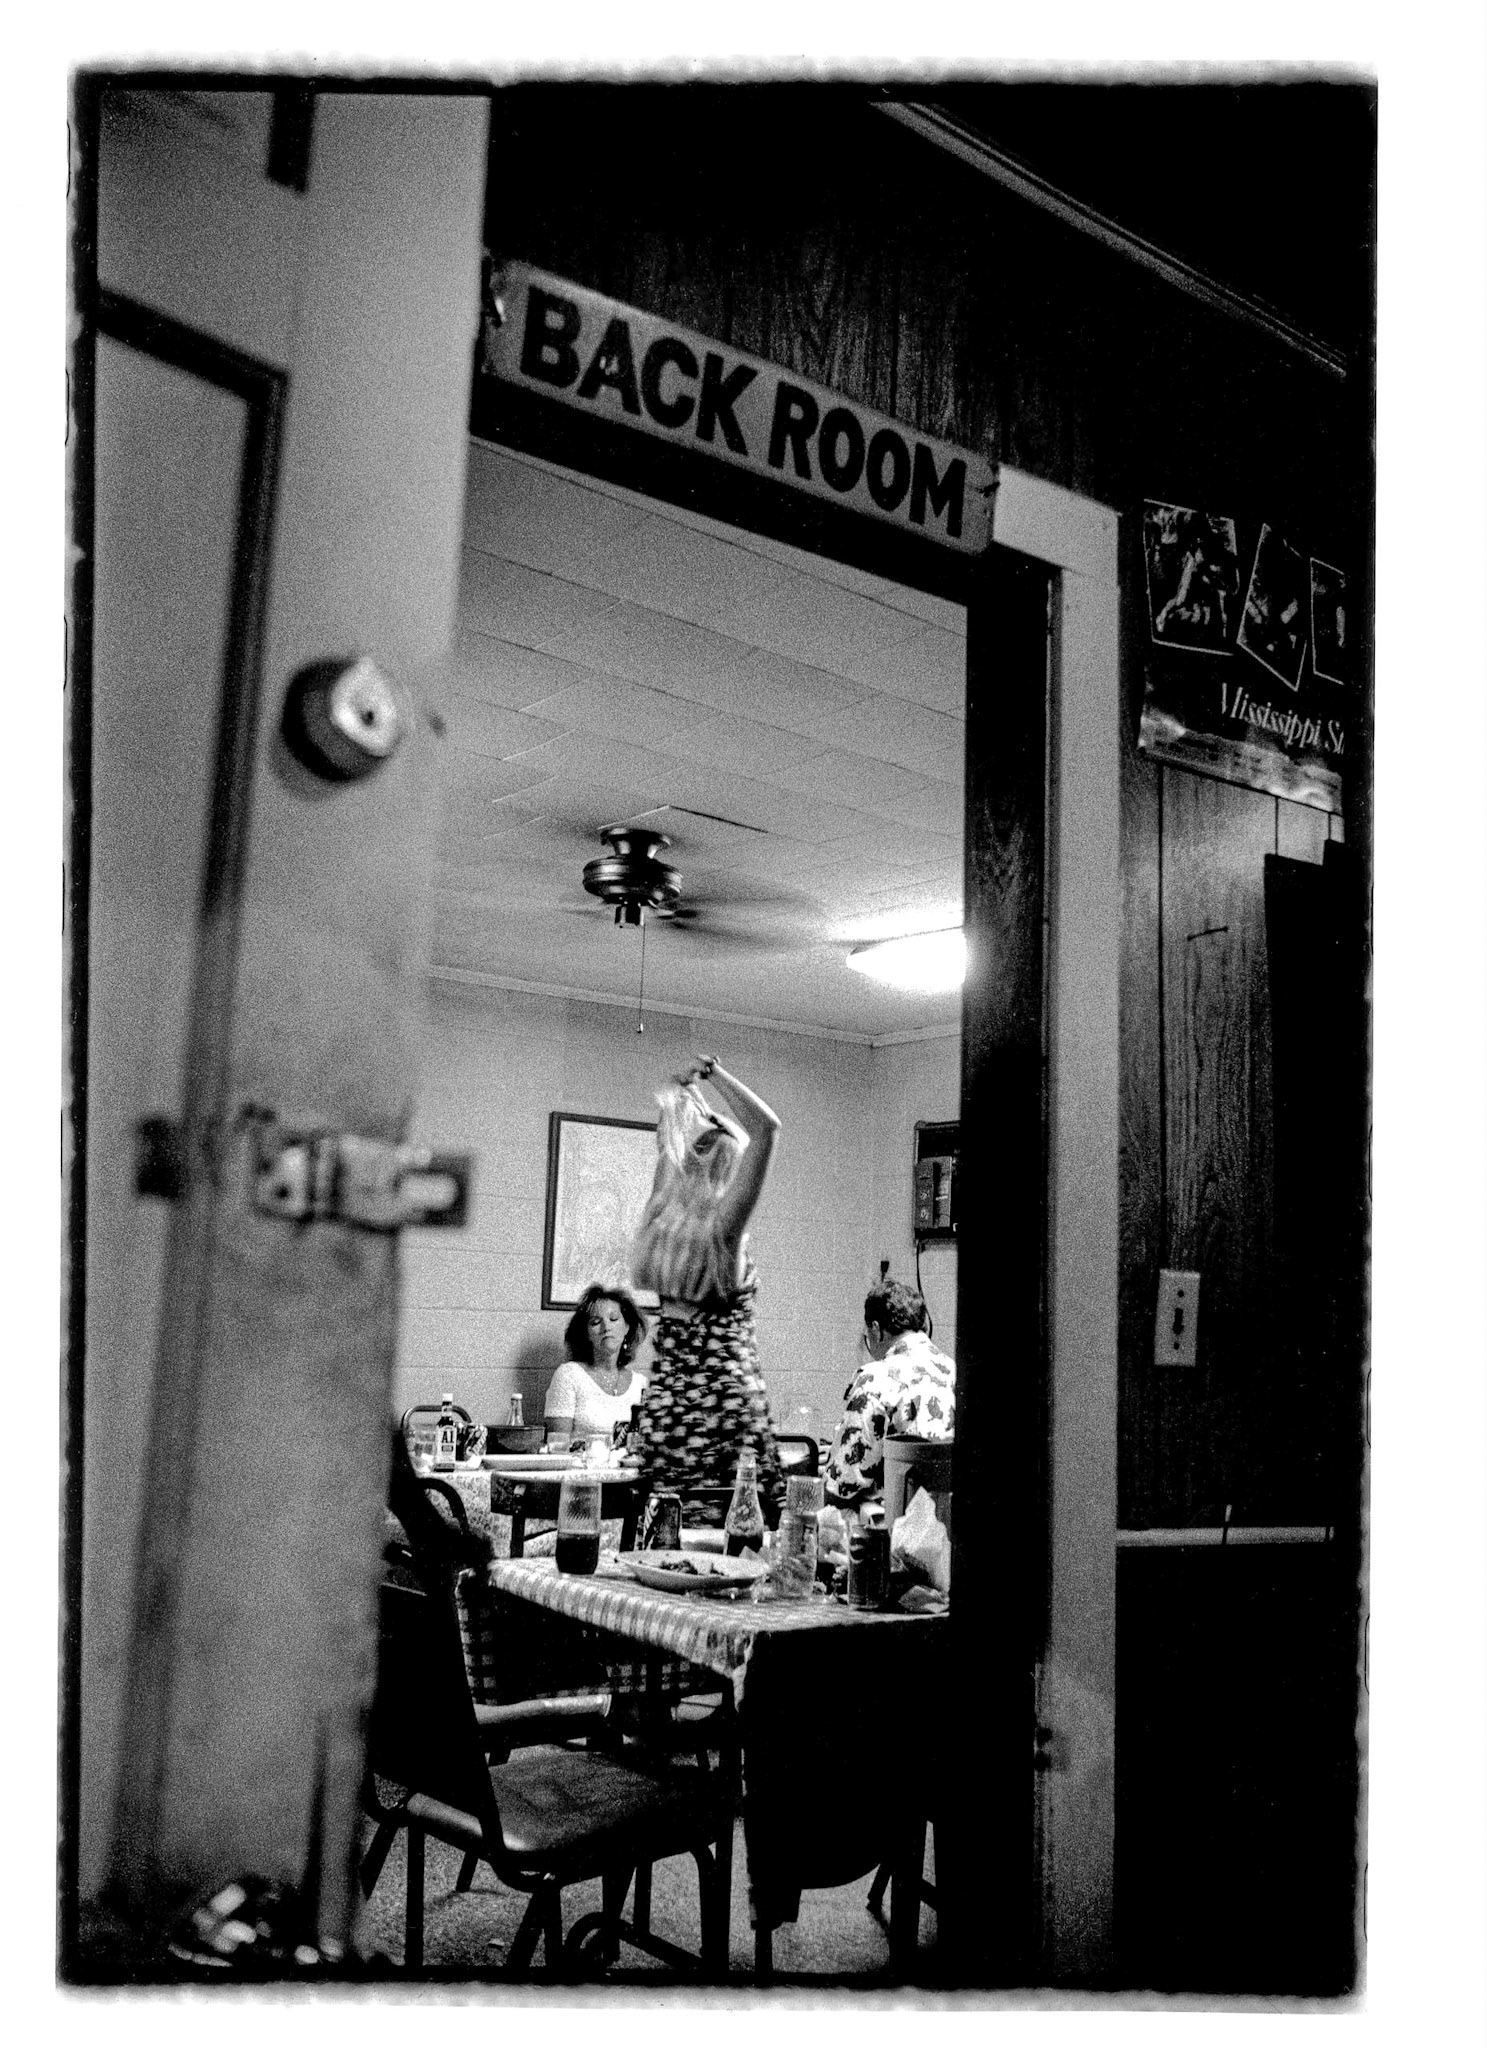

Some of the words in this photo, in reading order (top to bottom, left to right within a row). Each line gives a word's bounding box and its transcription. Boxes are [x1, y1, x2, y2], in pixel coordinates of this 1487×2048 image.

[519, 285, 759, 456] BACK
[767, 381, 968, 539] ROOM
[1220, 681, 1322, 748] Mississippi
